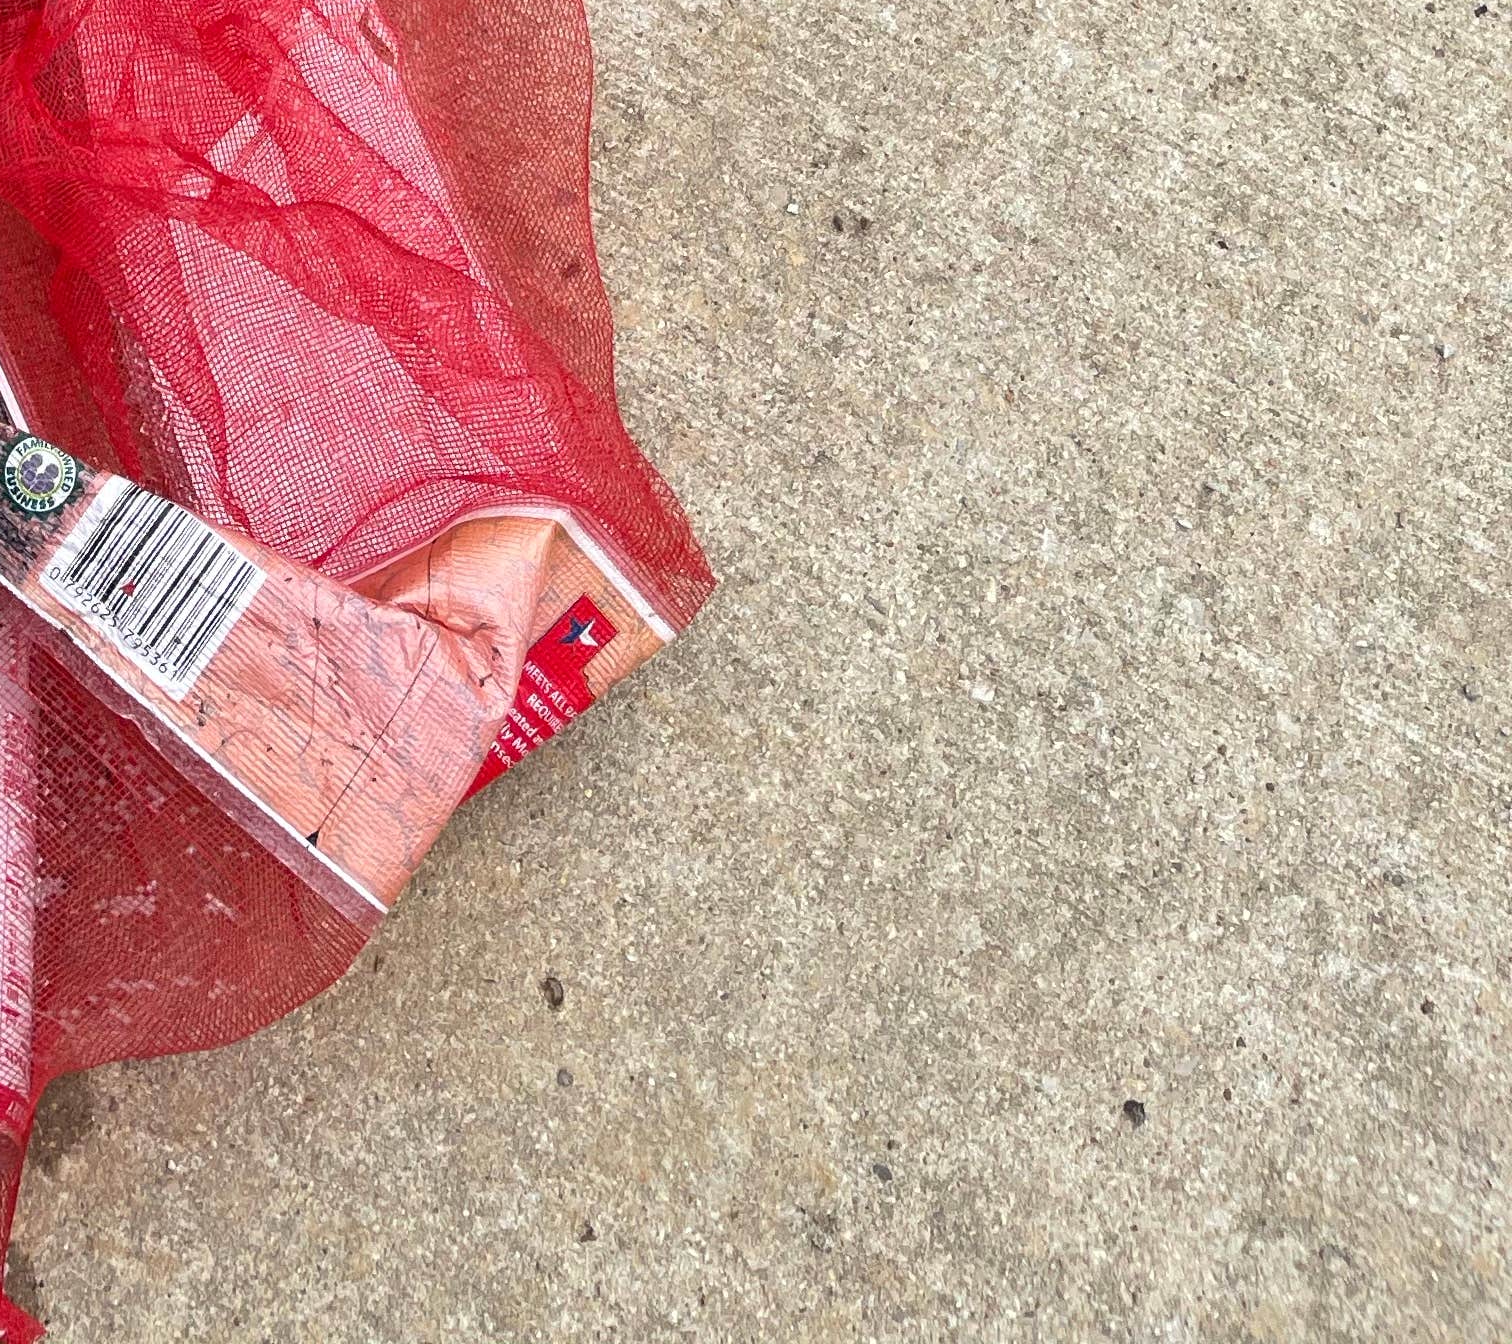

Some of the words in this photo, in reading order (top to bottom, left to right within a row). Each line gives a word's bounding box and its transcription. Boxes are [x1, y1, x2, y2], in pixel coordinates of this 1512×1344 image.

[6, 466, 56, 510] BUSINESS
[522, 660, 552, 694] MEETS
[548, 689, 569, 714] ALL
